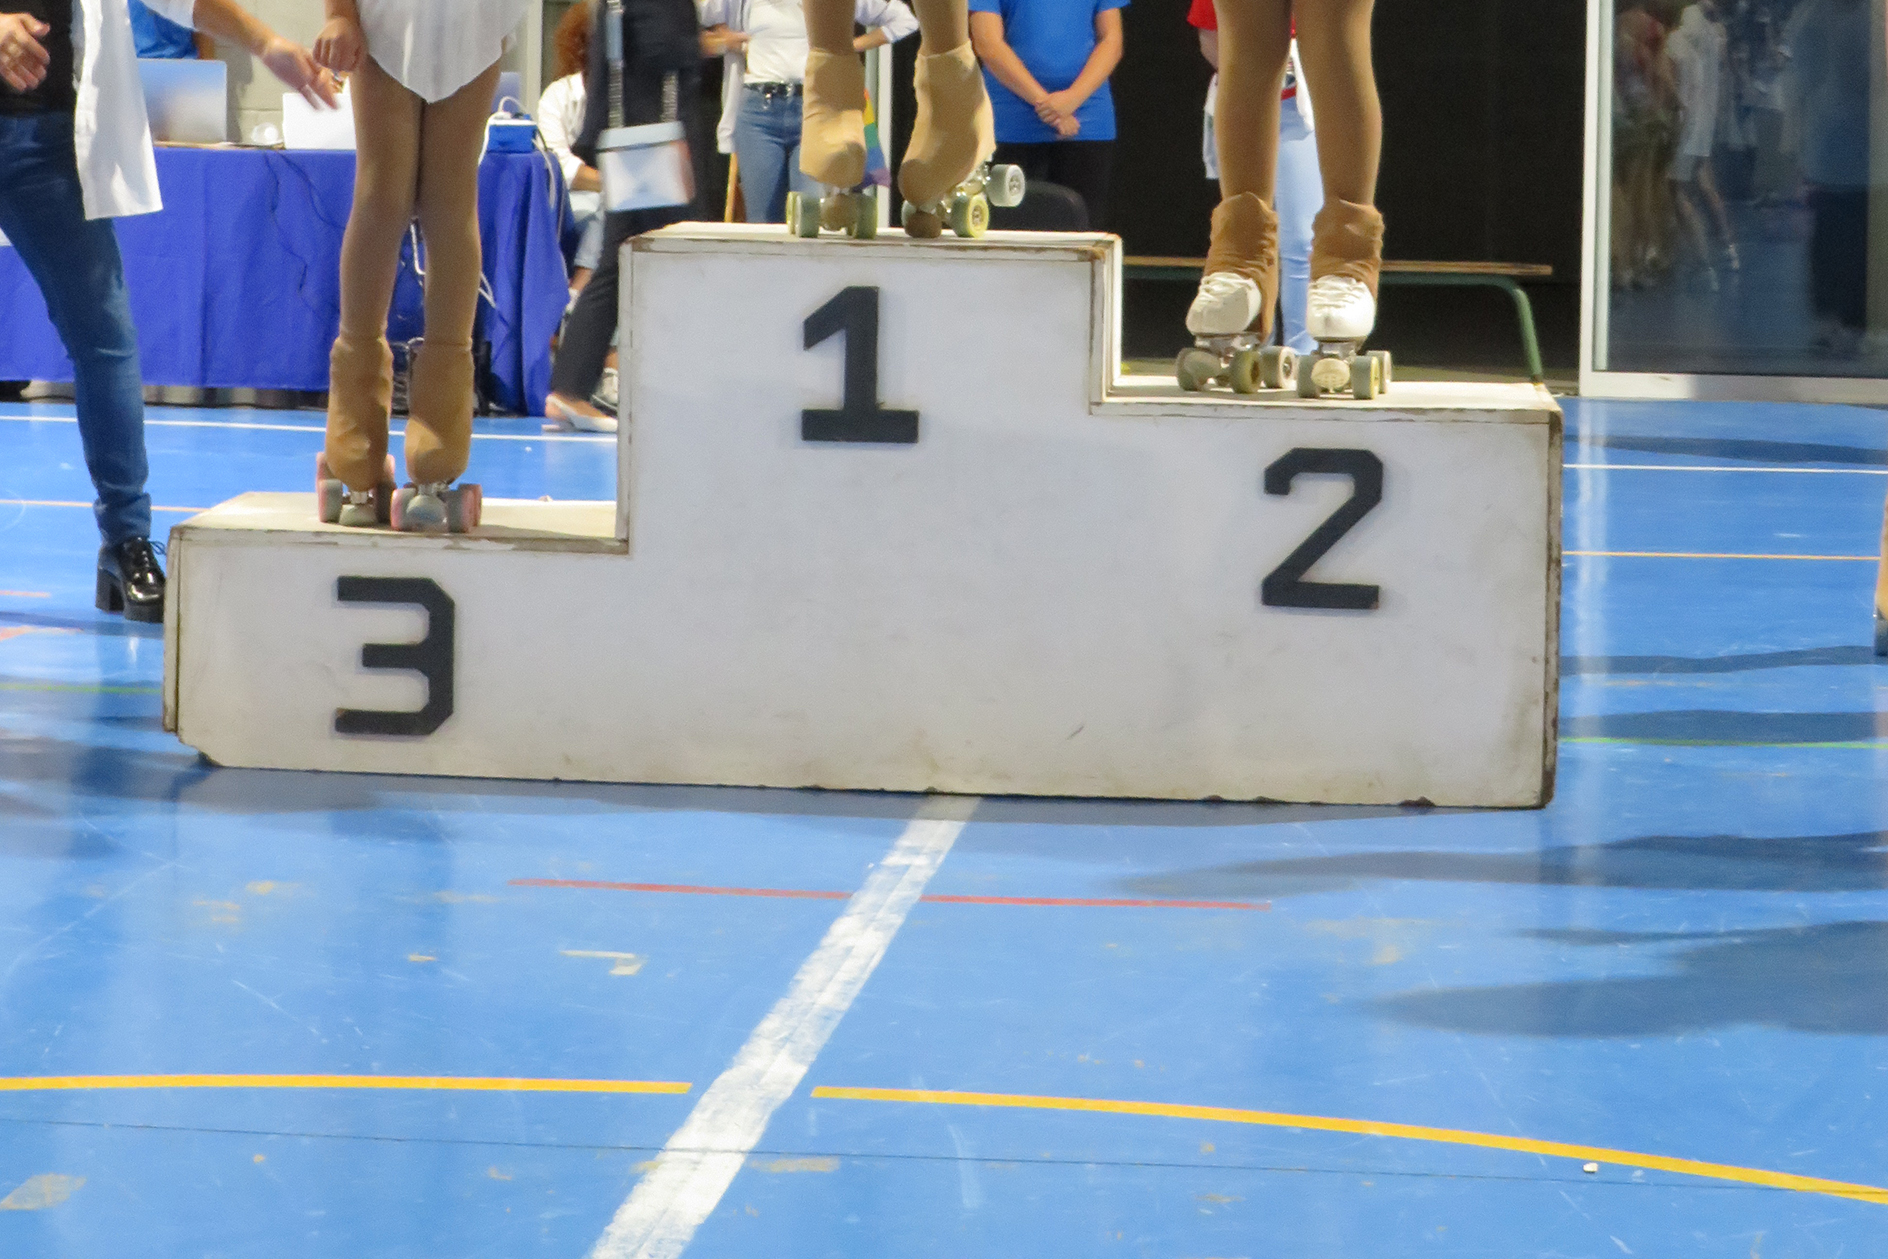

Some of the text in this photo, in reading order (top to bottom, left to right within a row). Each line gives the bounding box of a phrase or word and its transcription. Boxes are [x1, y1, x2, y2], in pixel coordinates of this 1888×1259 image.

[801, 287, 919, 444] 1
[1262, 448, 1384, 610] 2
[335, 576, 455, 737] 3
